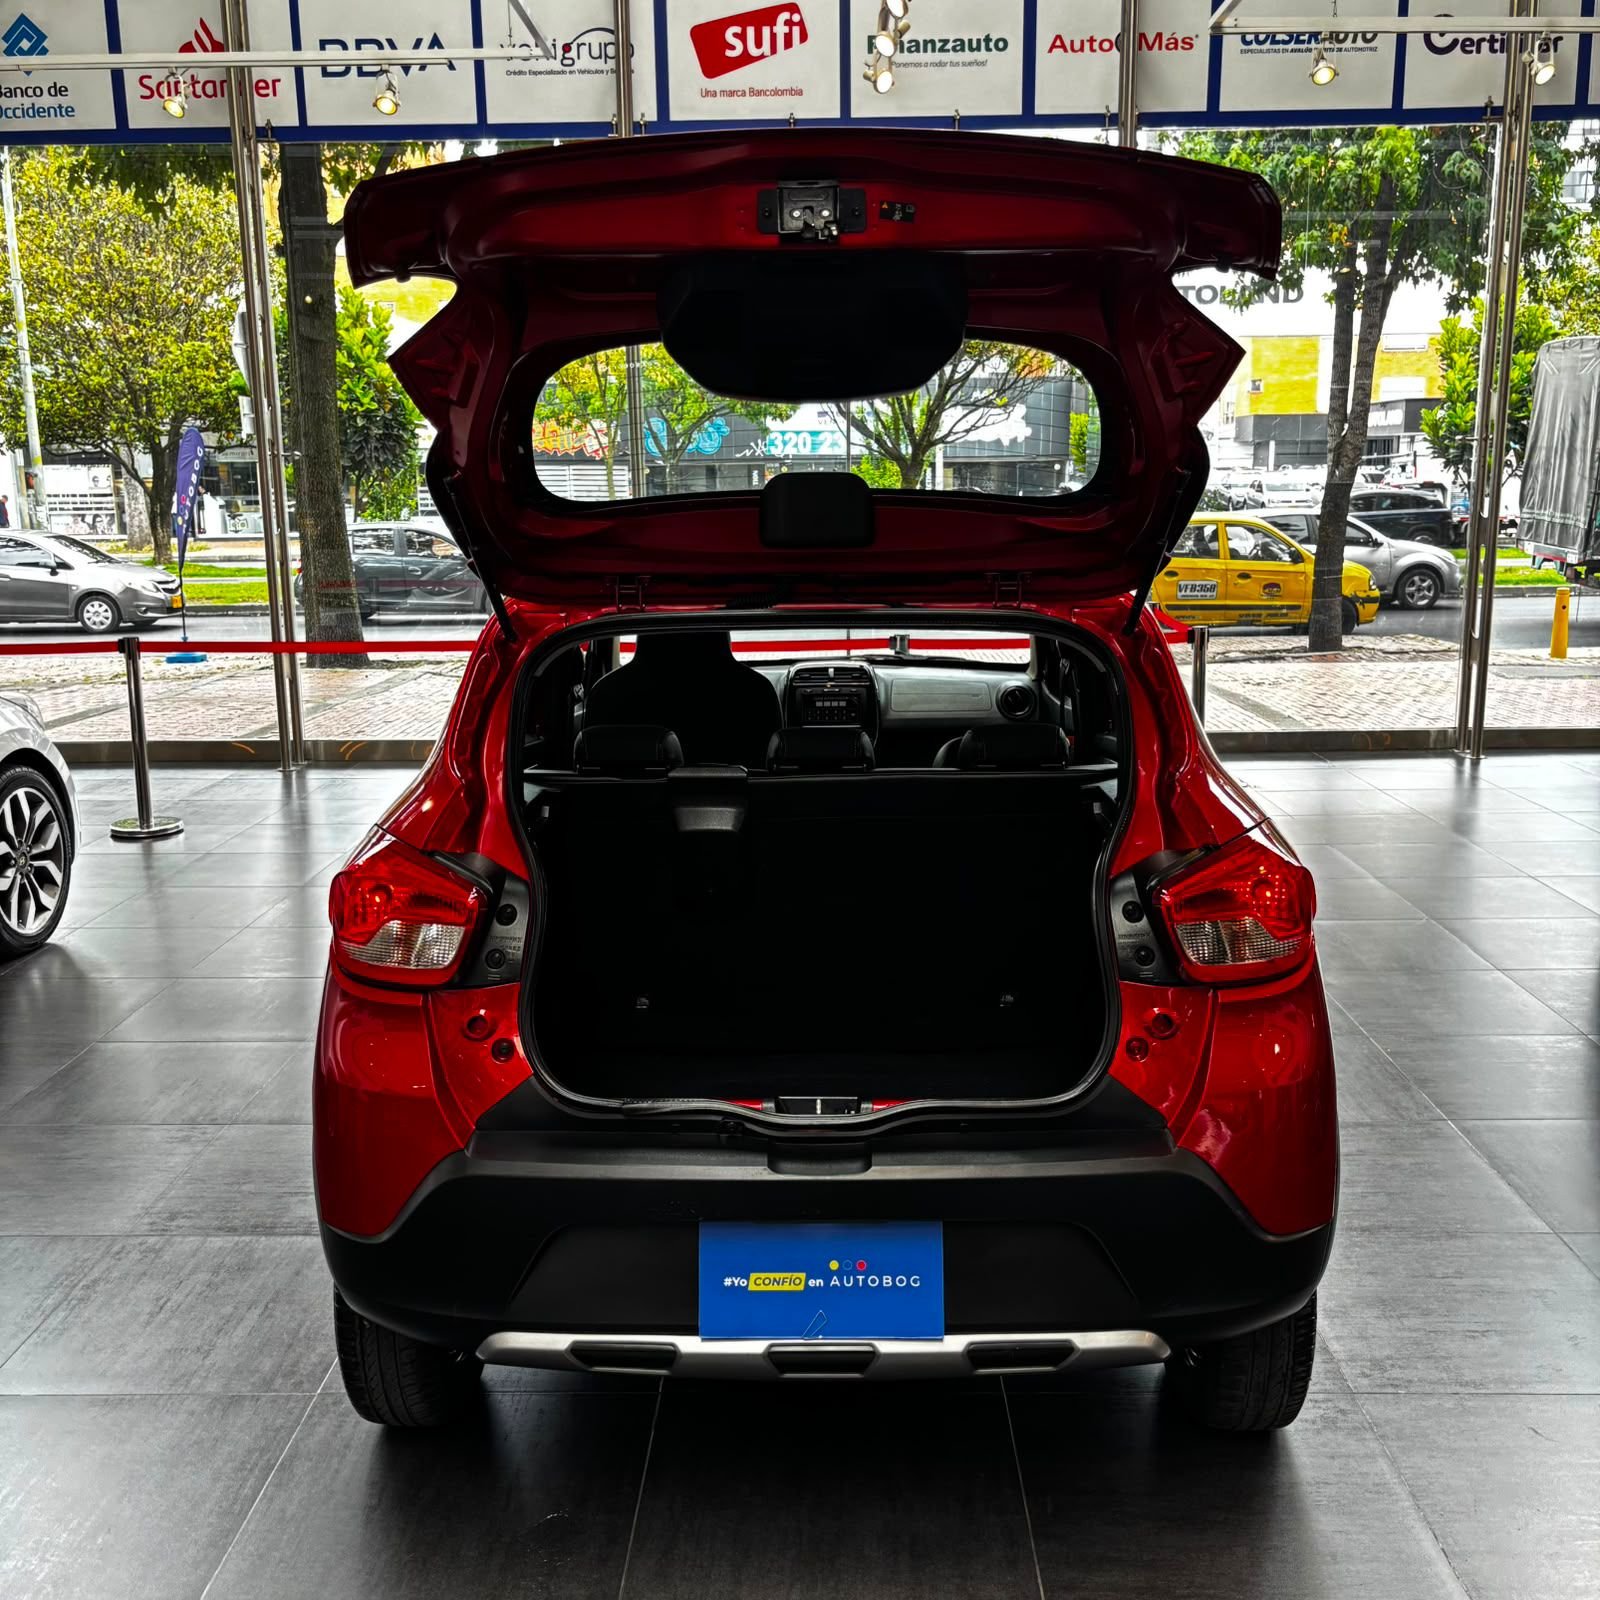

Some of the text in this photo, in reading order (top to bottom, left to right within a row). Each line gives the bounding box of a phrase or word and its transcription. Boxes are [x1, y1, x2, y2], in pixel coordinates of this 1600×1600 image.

[724, 12, 801, 58] sufi
[867, 33, 1009, 55] Fanzauto
[318, 32, 457, 78] BBVA
[891, 60, 922, 69] Ponemos
[929, 59, 948, 68] rodar
[949, 60, 960, 68] tus
[47, 81, 69, 98] de
[138, 74, 281, 100] Santaner
[700, 86, 803, 98] Una marca Bancolombia
[769, 432, 812, 455] 320
[723, 1273, 921, 1287] #Yo CONFÍO en AUTOBOG
